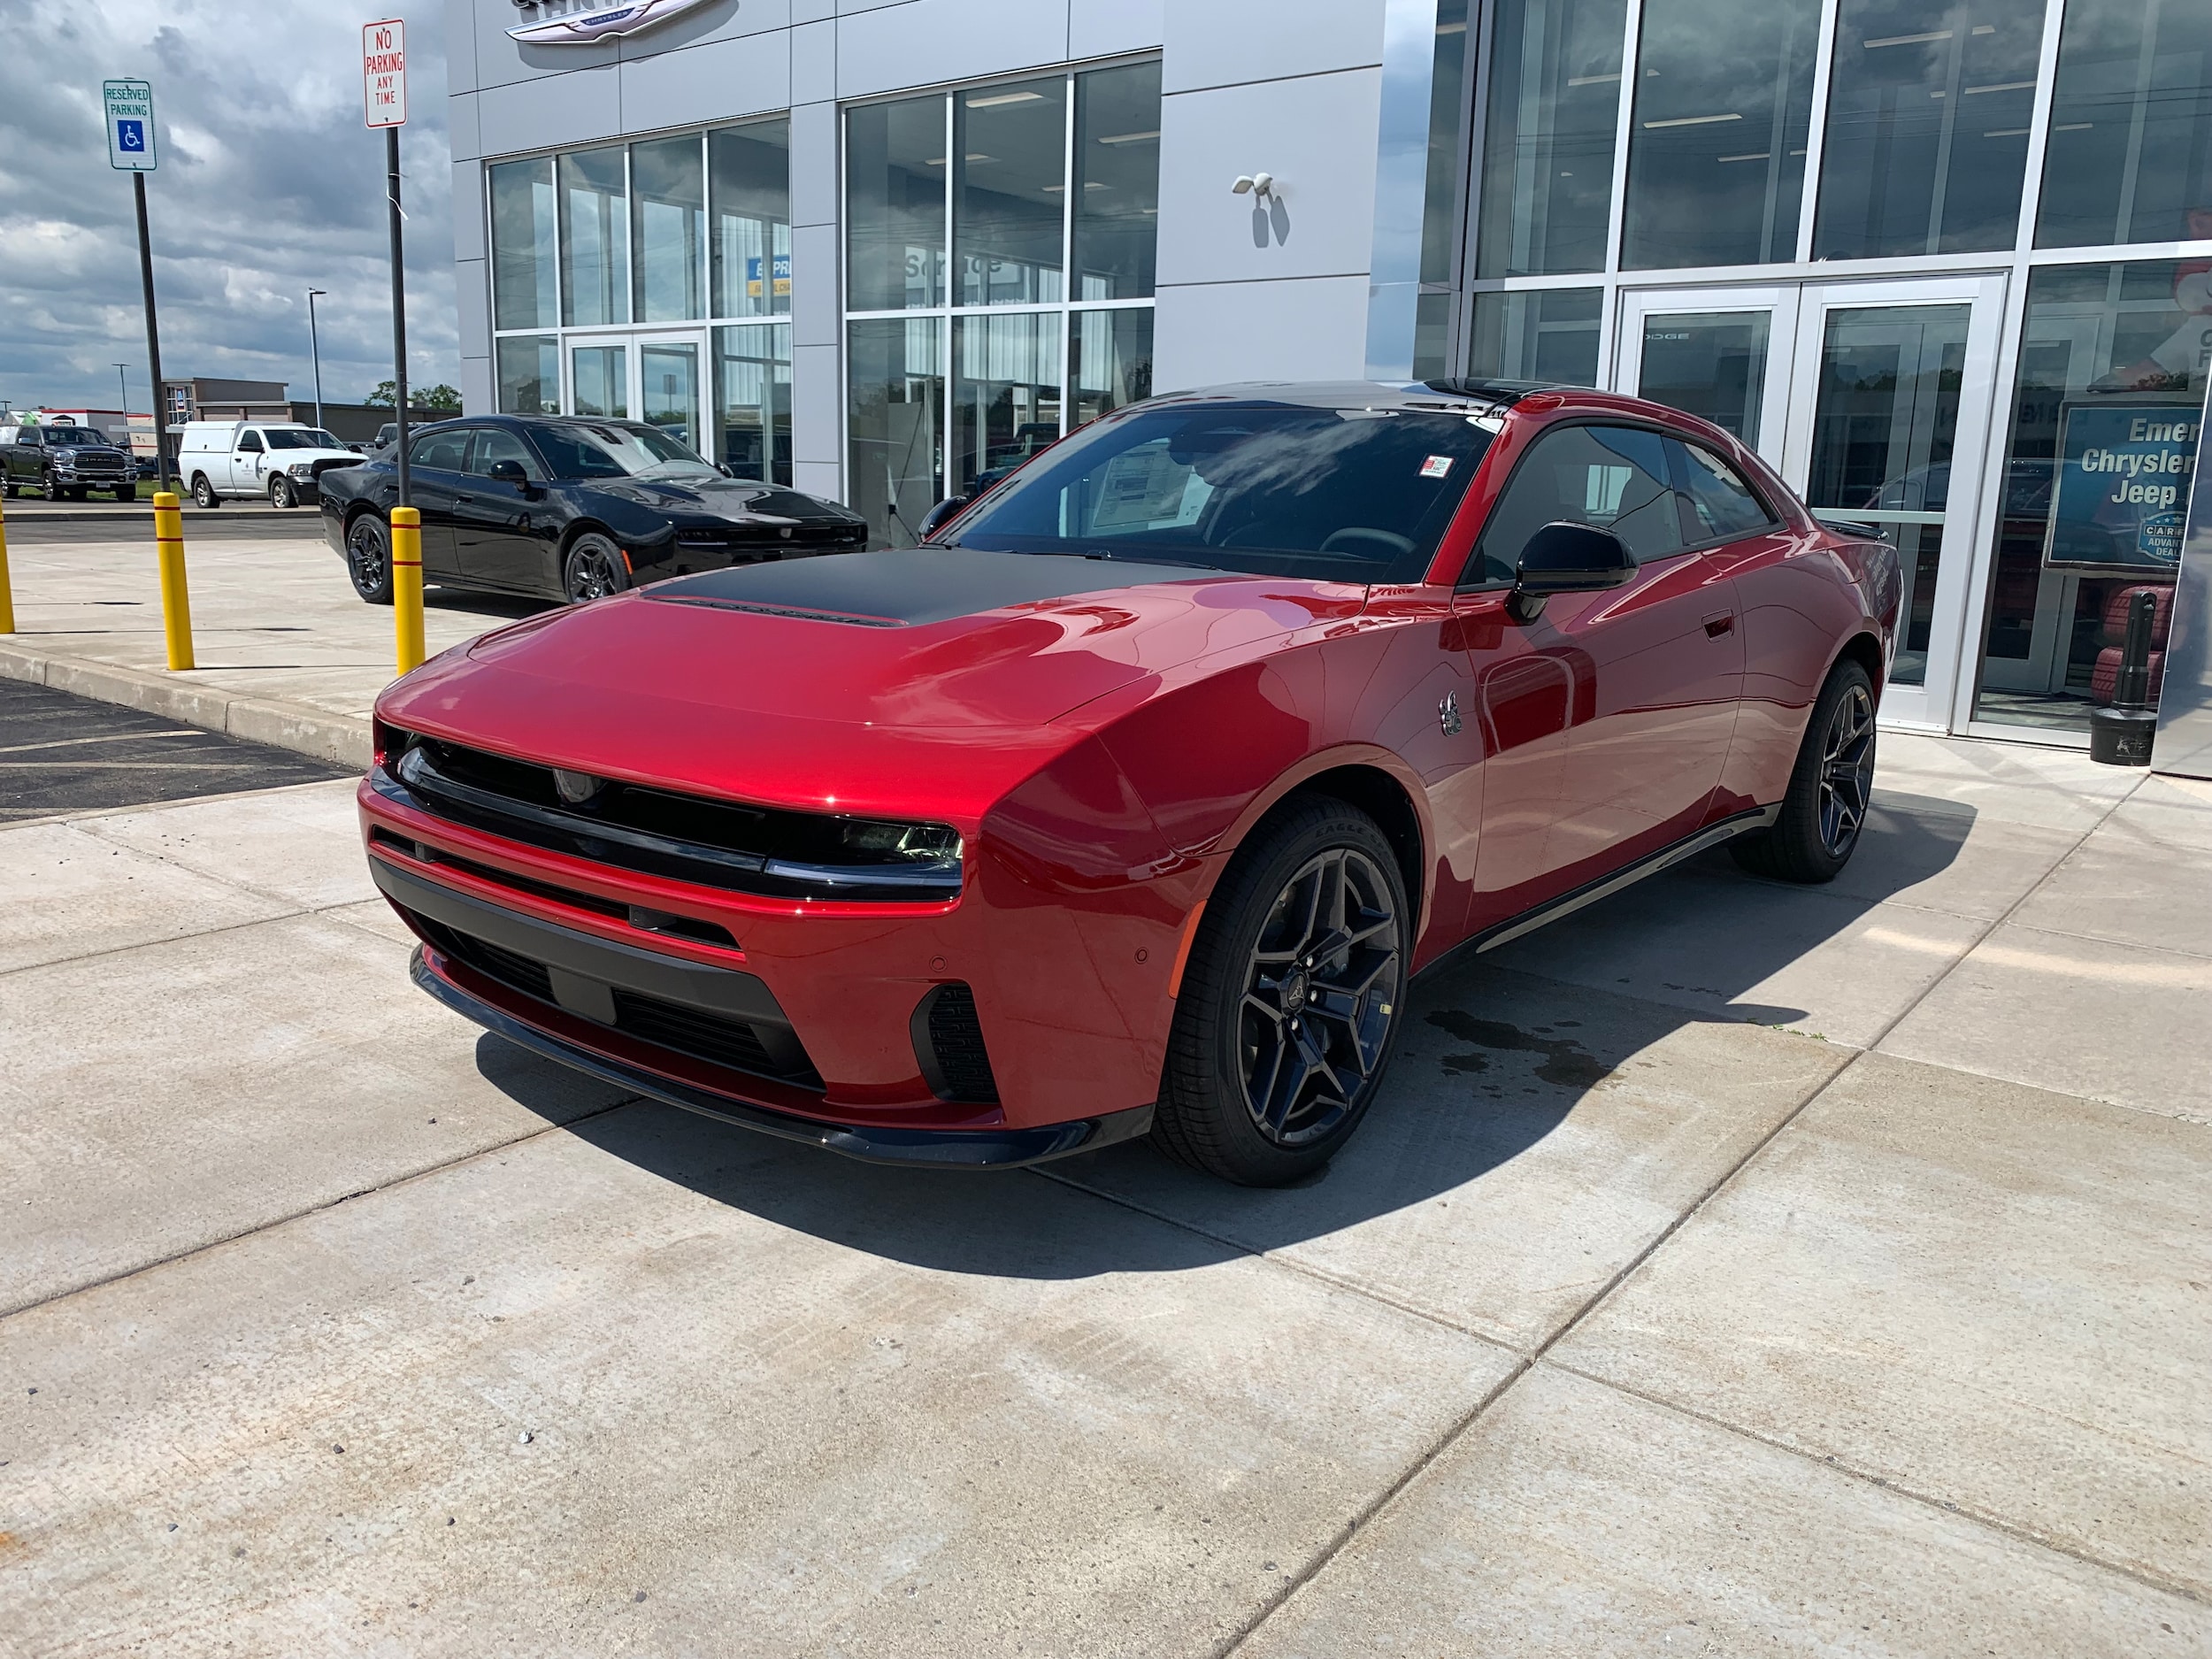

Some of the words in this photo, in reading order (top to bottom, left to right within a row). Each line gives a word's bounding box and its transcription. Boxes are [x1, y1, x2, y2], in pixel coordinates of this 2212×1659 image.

[586, 11, 628, 25] CHRYSLER
[376, 30, 391, 50] NO
[366, 51, 403, 75] PARKING
[377, 75, 393, 89] ANY
[106, 88, 149, 100] RESERVED
[375, 90, 396, 105] TIME
[111, 104, 147, 116] PARKING
[756, 260, 790, 276] EPR
[2082, 448, 2196, 478] Chrysler
[2111, 480, 2177, 510] Jeep
[2155, 547, 2181, 557] DEAL
